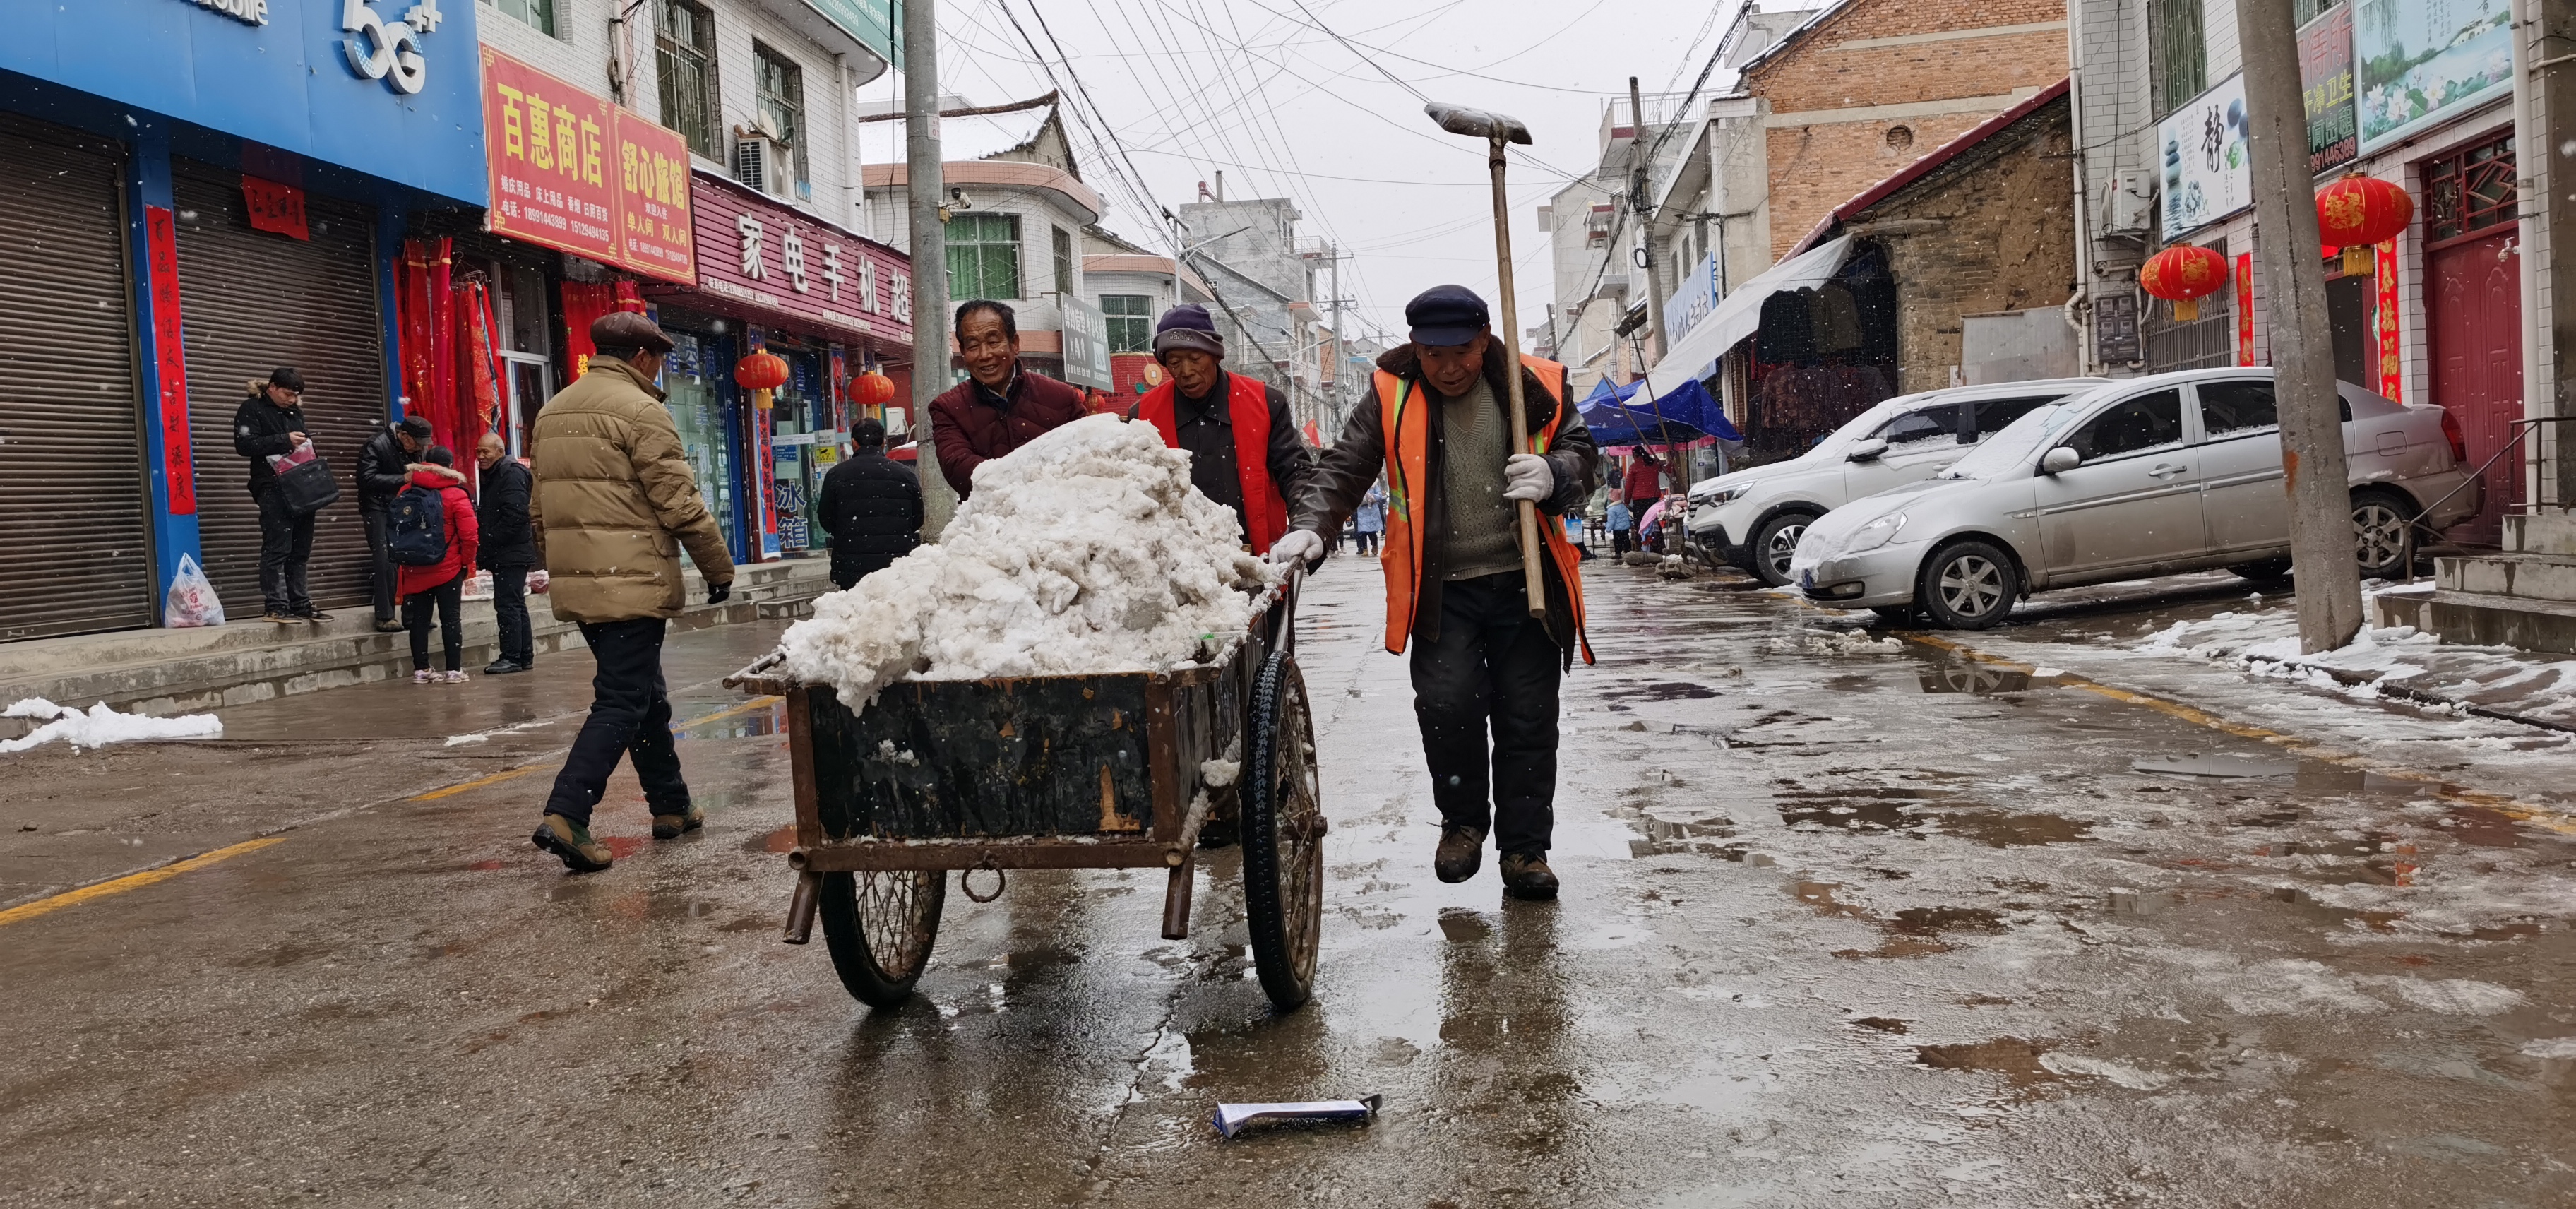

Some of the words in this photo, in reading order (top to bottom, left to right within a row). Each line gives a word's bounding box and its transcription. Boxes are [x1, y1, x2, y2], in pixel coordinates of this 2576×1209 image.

[826, 0, 859, 27] 220992459
[497, 82, 602, 189] 百惠商店
[2201, 104, 2224, 174] 静
[501, 174, 531, 199] 婚庆用品
[535, 186, 564, 209] 床上用品
[568, 196, 581, 215] 香烟
[583, 202, 609, 223] 日用百货
[621, 138, 685, 210] 舒心旅馆
[571, 220, 609, 242] 15129494135
[627, 211, 654, 238] 单人间
[662, 223, 687, 247] 双人间
[645, 202, 667, 220] 欢迎入住
[777, 480, 809, 548] 冰箱
